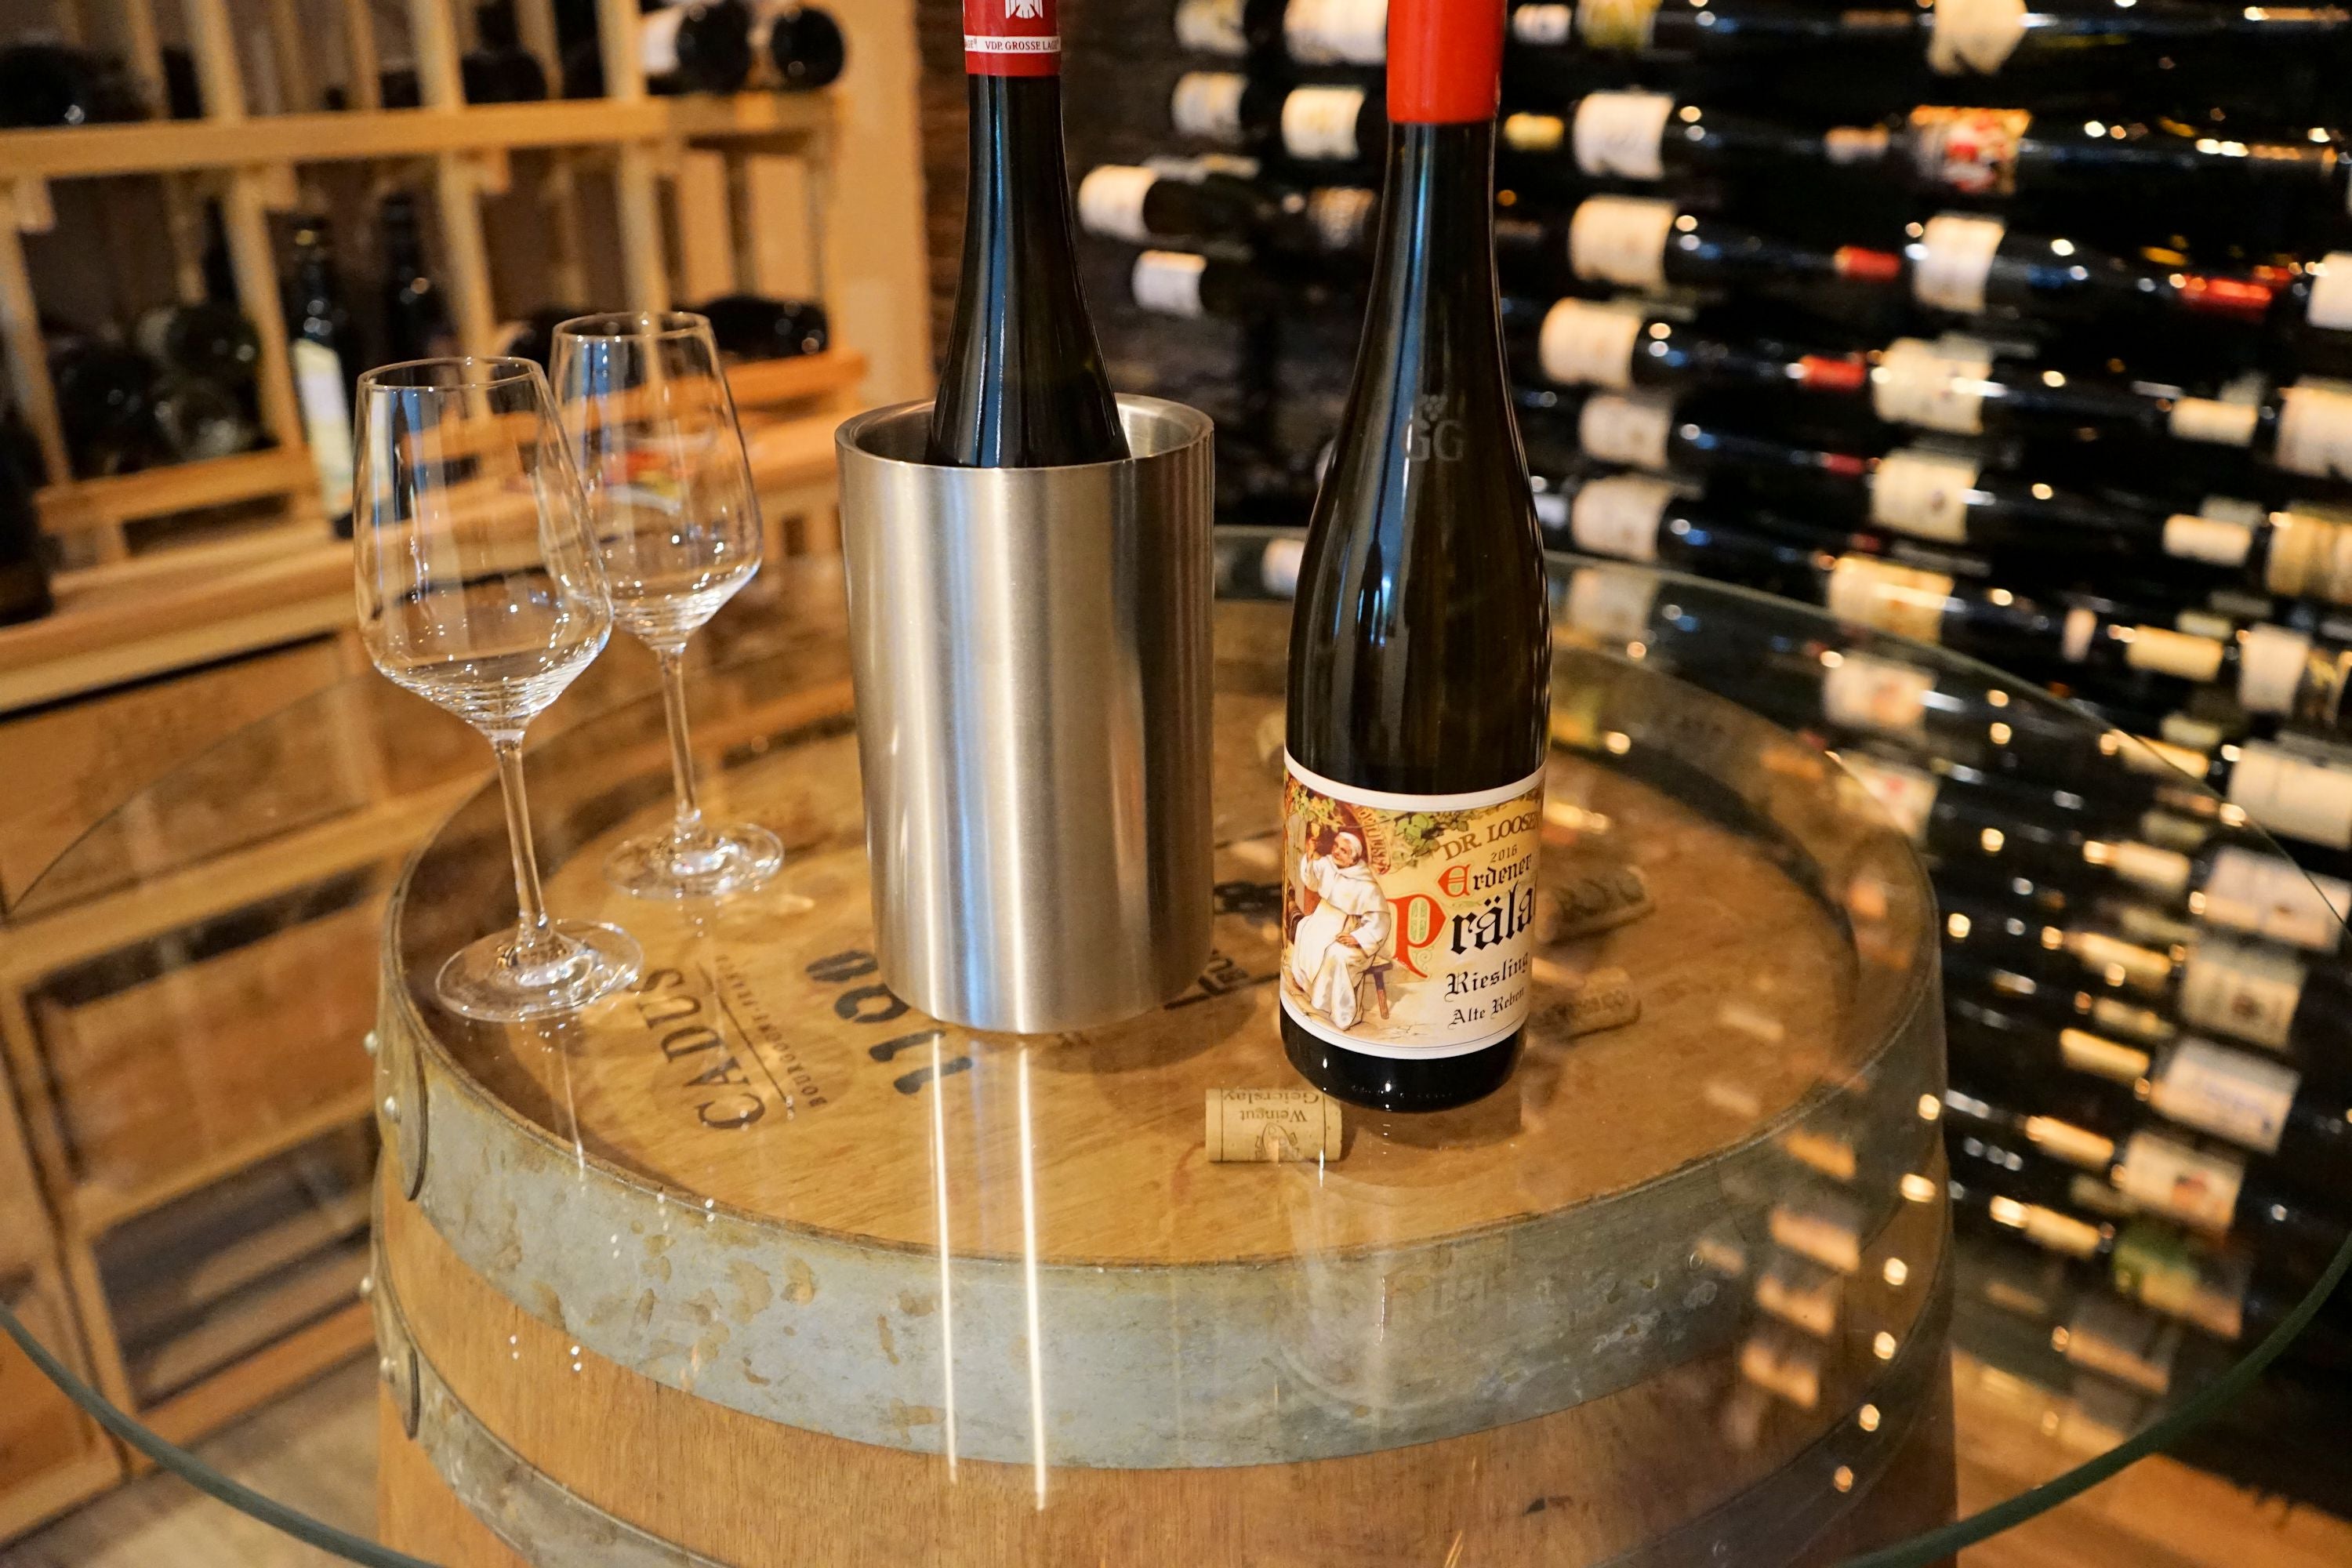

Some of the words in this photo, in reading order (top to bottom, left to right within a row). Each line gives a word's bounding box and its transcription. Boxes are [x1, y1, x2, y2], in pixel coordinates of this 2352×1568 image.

[985, 41, 1003, 50] VDP.
[1005, 41, 1040, 50] GROSSE
[1441, 833, 1483, 861] DR.
[1490, 844, 1518, 862] 2016
[1438, 852, 1532, 898] Erdener
[1387, 879, 1536, 979] Präla
[1444, 952, 1529, 1003] Riesling
[1447, 1007, 1486, 1030] Alte
[1490, 986, 1525, 1019] Reben
[626, 967, 766, 1130] CADUS
[1223, 1091, 1319, 1105] Geierslay
[1239, 1107, 1308, 1123] Weingut
